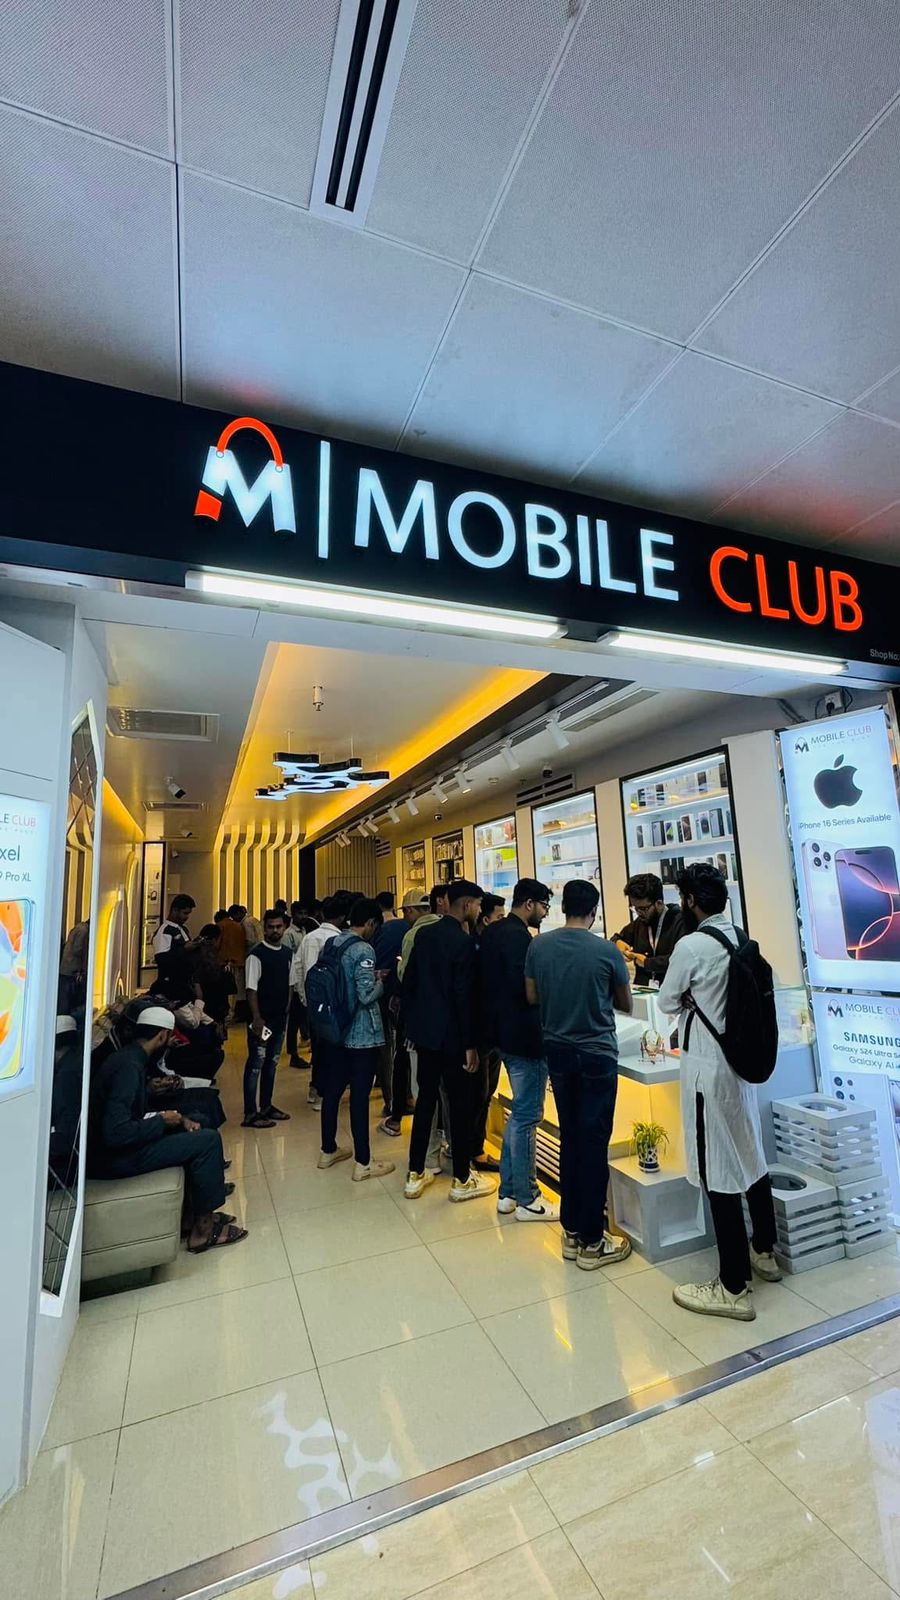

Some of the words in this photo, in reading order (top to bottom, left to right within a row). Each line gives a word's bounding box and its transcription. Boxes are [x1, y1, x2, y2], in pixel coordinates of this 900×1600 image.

[354, 467, 680, 601] MOBILE
[709, 545, 864, 632] CLUB
[870, 648, 888, 661] Shop
[811, 730, 845, 744] MOBILE
[847, 725, 872, 737] CLUB
[12, 814, 36, 827] CLUB
[799, 821, 821, 830] iPhone
[823, 819, 831, 827] 16
[832, 818, 855, 827] Series
[857, 813, 892, 824] Available
[5, 871, 20, 882] Pro
[22, 872, 32, 882] XL
[845, 1003, 884, 1015] MOBILE
[843, 1031, 900, 1048] SAMSUNG
[832, 1044, 858, 1054] Galaxy
[860, 1048, 873, 1056] S24
[874, 1049, 893, 1058] Ultra
[849, 1056, 883, 1070] Galaxy
[885, 1061, 895, 1069] AI
